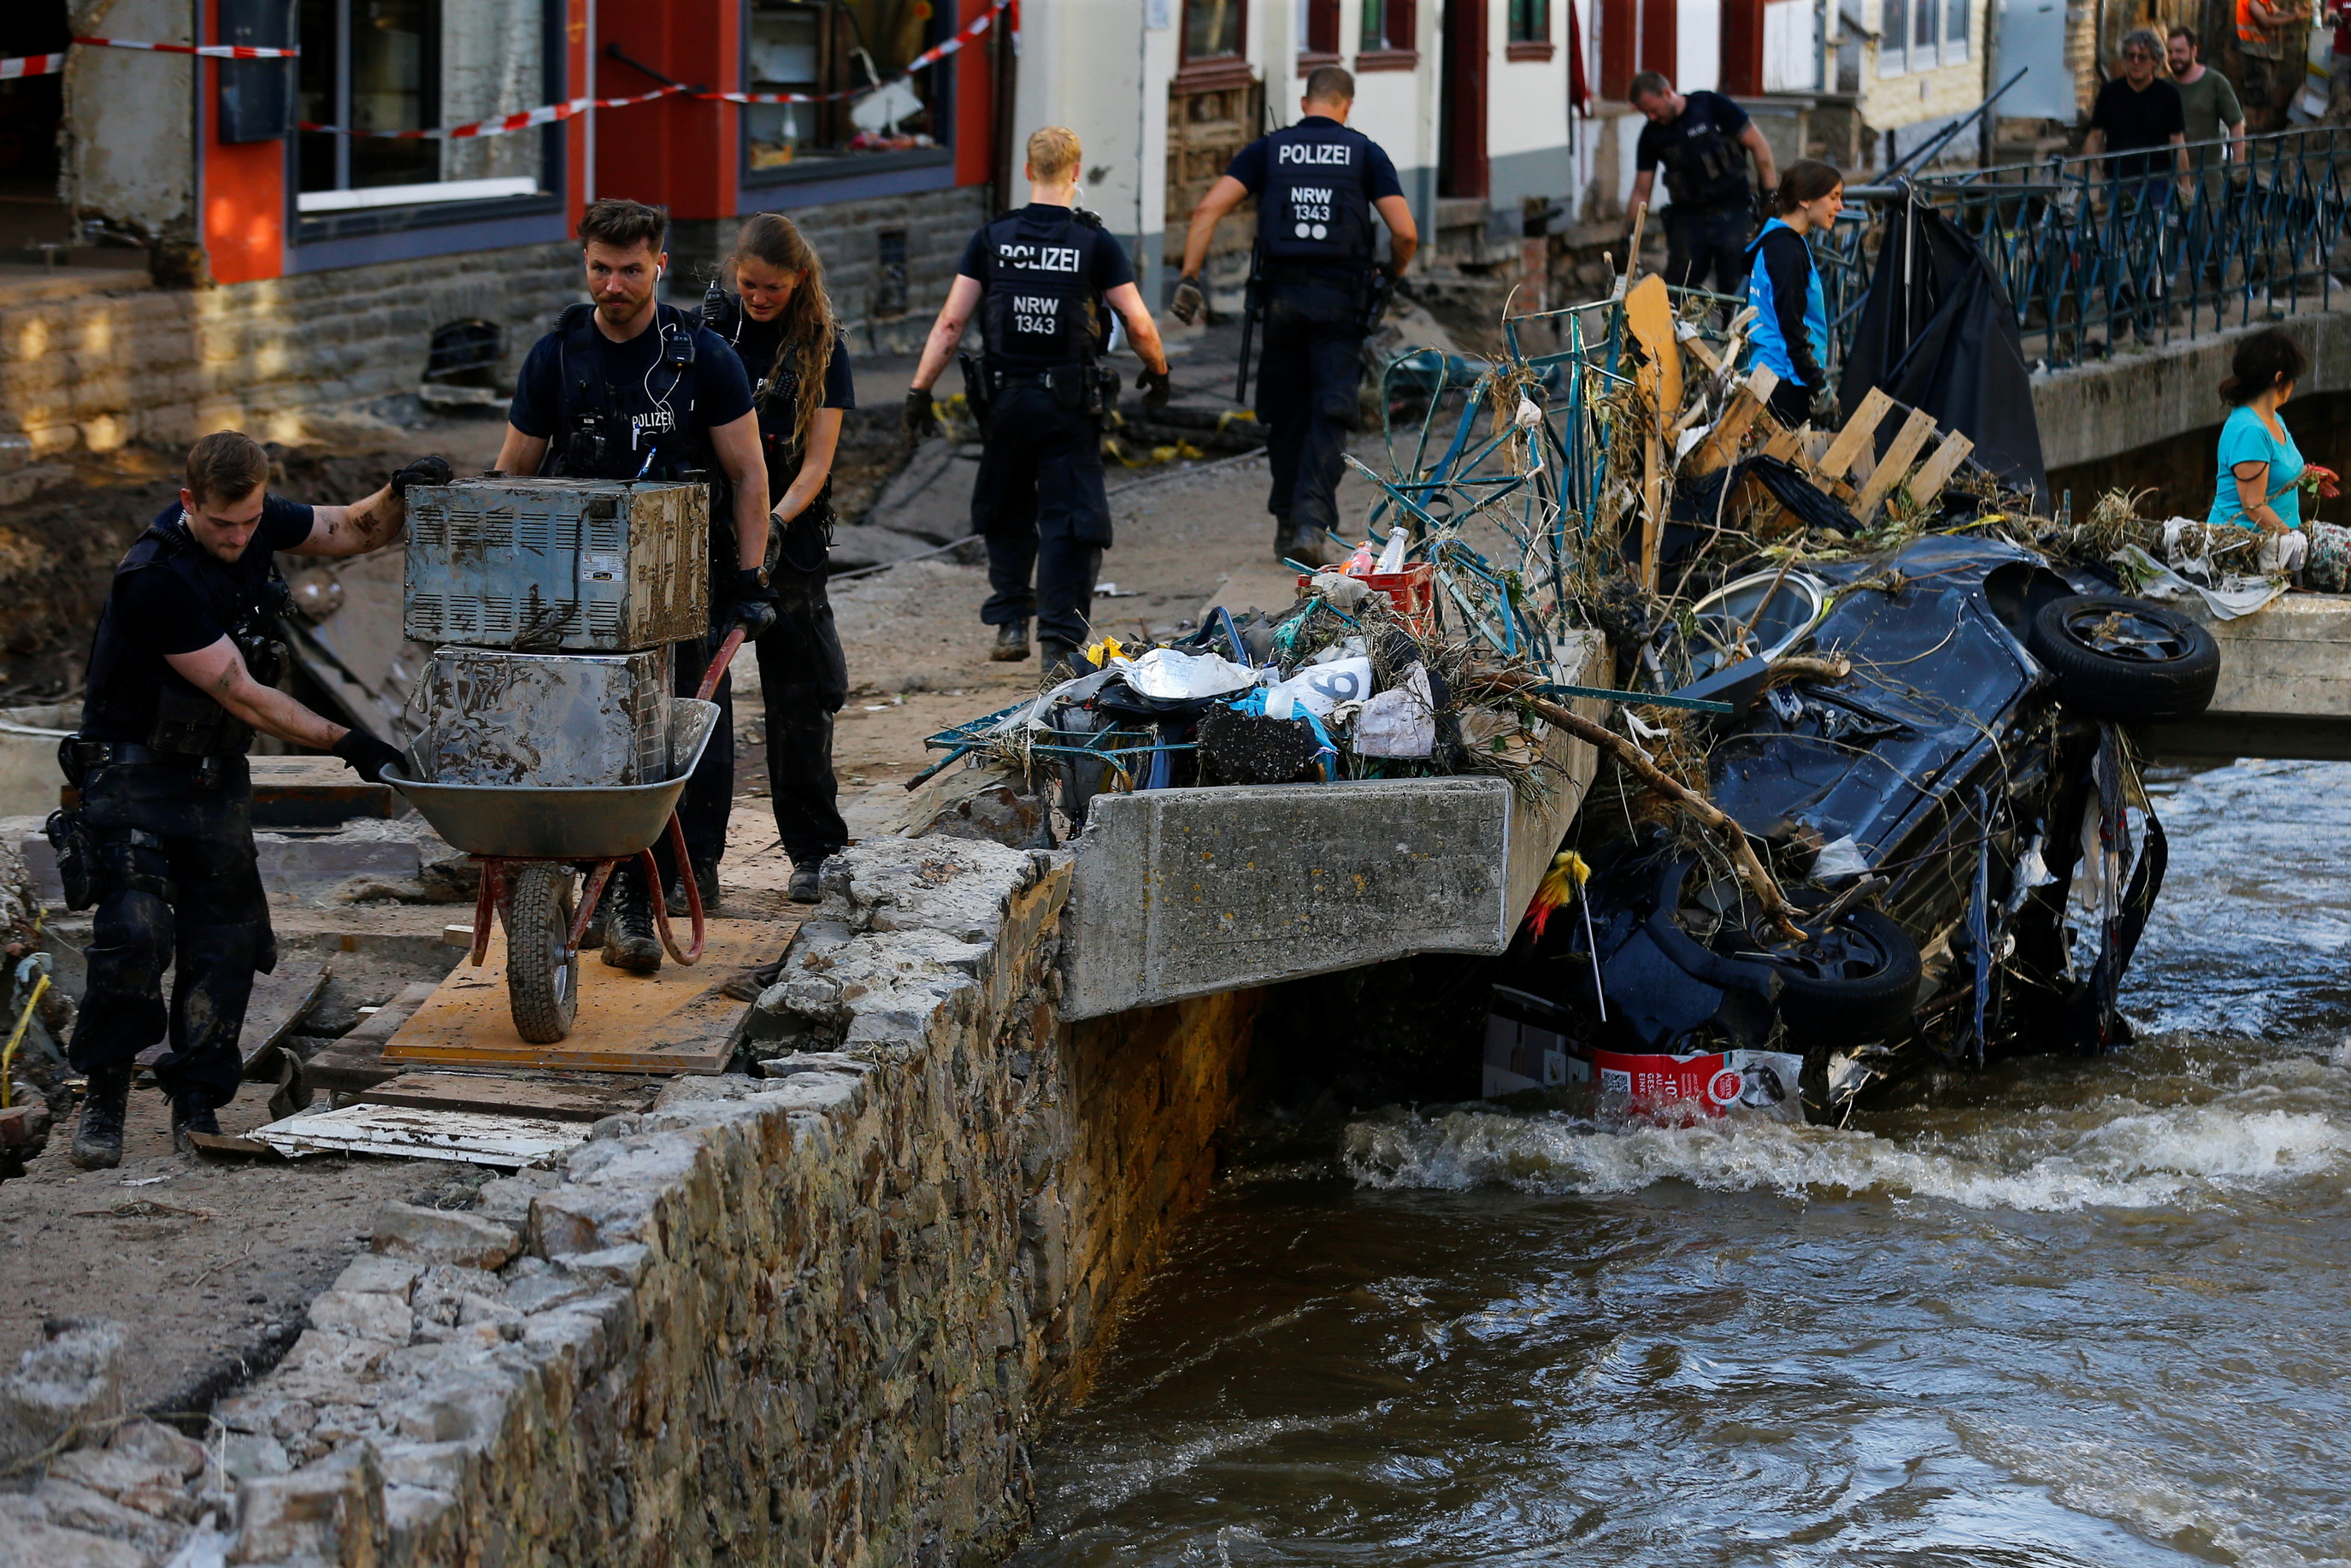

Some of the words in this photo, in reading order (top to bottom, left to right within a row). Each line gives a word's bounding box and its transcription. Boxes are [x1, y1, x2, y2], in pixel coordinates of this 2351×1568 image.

[1279, 144, 1351, 165] POLIZEI
[1291, 186, 1333, 203] NRW
[1293, 204, 1330, 221] 1343
[999, 244, 1080, 272] POLIZEI
[1013, 295, 1058, 315] NRW
[1015, 315, 1055, 334] 1343
[632, 411, 671, 429] POLIZEI
